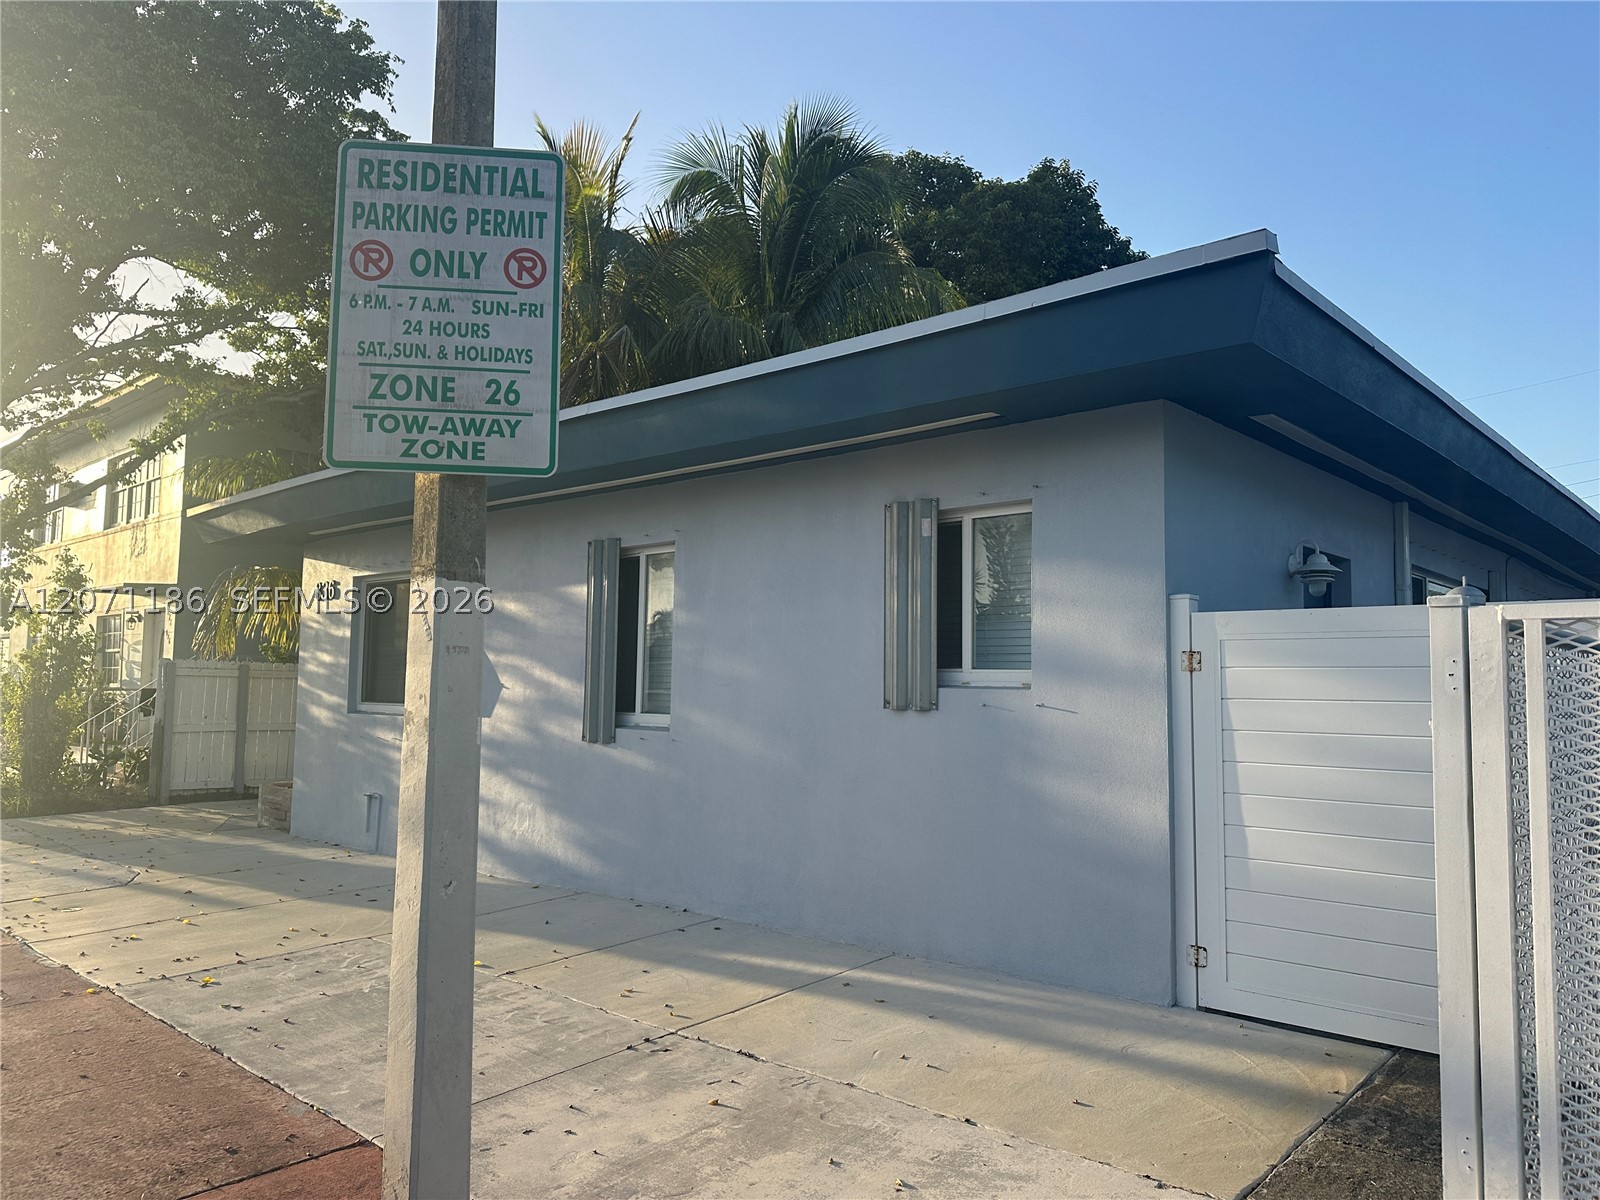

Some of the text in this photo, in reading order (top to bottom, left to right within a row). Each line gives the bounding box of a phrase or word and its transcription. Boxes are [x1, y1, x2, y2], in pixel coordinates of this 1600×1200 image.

[357, 158, 545, 199] RESIDENTIAL
[351, 200, 548, 240] PARKING PERMIT
[409, 248, 487, 280] ONLY
[349, 293, 358, 309] 6
[363, 294, 392, 310] P.M.
[408, 296, 418, 311] 7
[421, 297, 455, 313] A.M.
[471, 300, 545, 319] SUN-FRI
[402, 320, 490, 340] 24 HOURS
[437, 345, 448, 360] &
[454, 345, 533, 365] HOLIDAYS
[369, 373, 521, 406] ZONE 26
[363, 413, 523, 440] TOW-AWAY
[400, 438, 486, 461] ZONE
